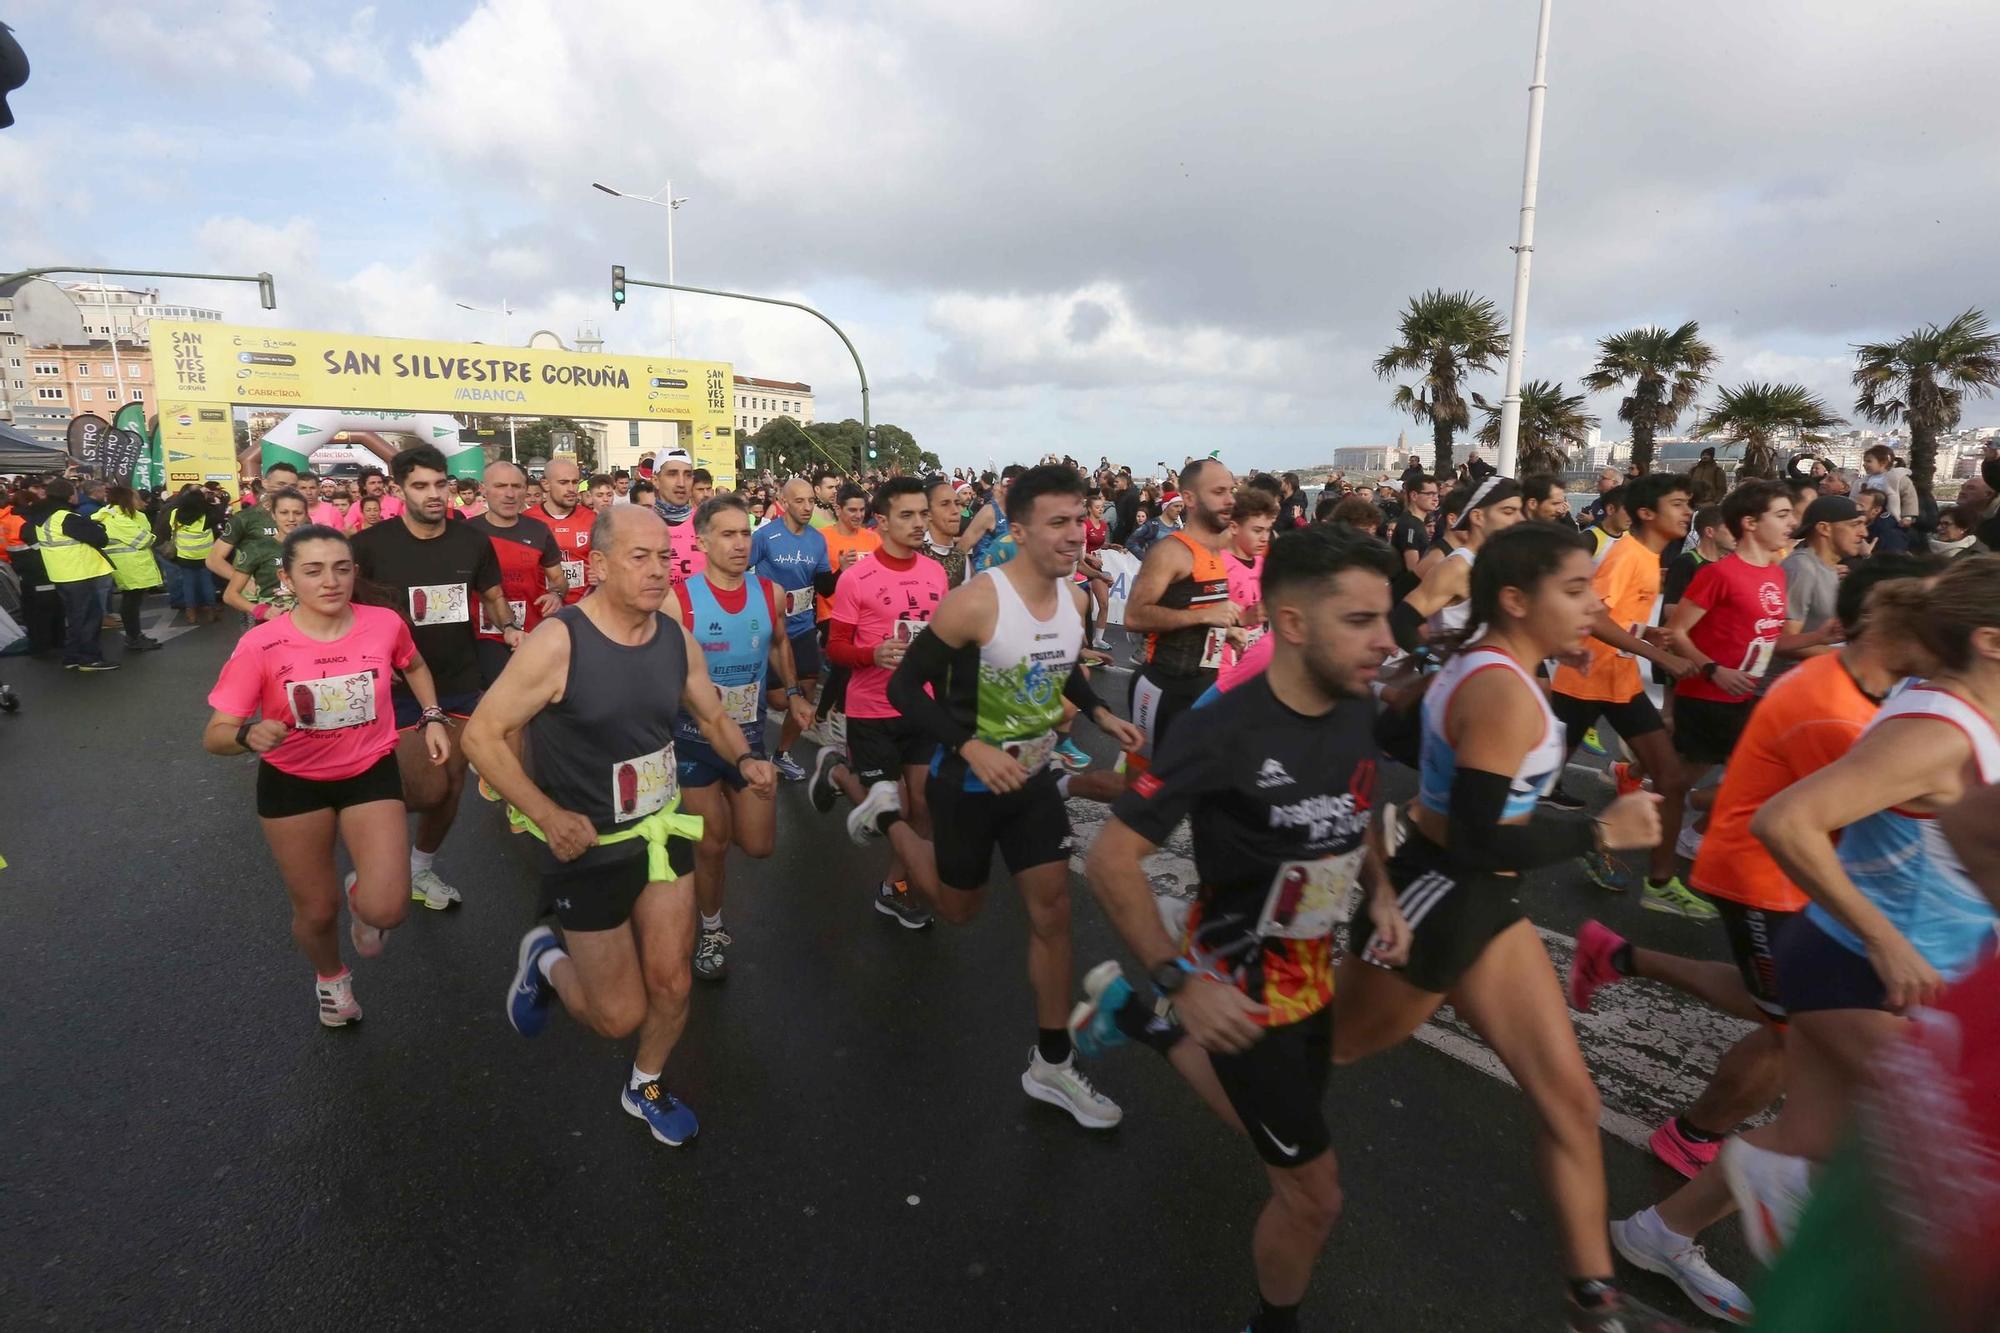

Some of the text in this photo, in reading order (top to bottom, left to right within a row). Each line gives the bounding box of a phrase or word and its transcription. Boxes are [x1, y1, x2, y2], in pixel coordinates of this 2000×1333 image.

[171, 331, 202, 344] SAN
[173, 344, 204, 358] SIL
[174, 358, 205, 371] VES
[324, 349, 630, 390] SAN SILVESTRE CORUÑA
[176, 371, 207, 384] TRE
[706, 369, 724, 379] SAN
[707, 379, 724, 389] SIL
[707, 389, 725, 399] VES
[707, 399, 725, 409] TRE
[83, 423, 97, 461] STRO
[747, 445, 754, 455] P
